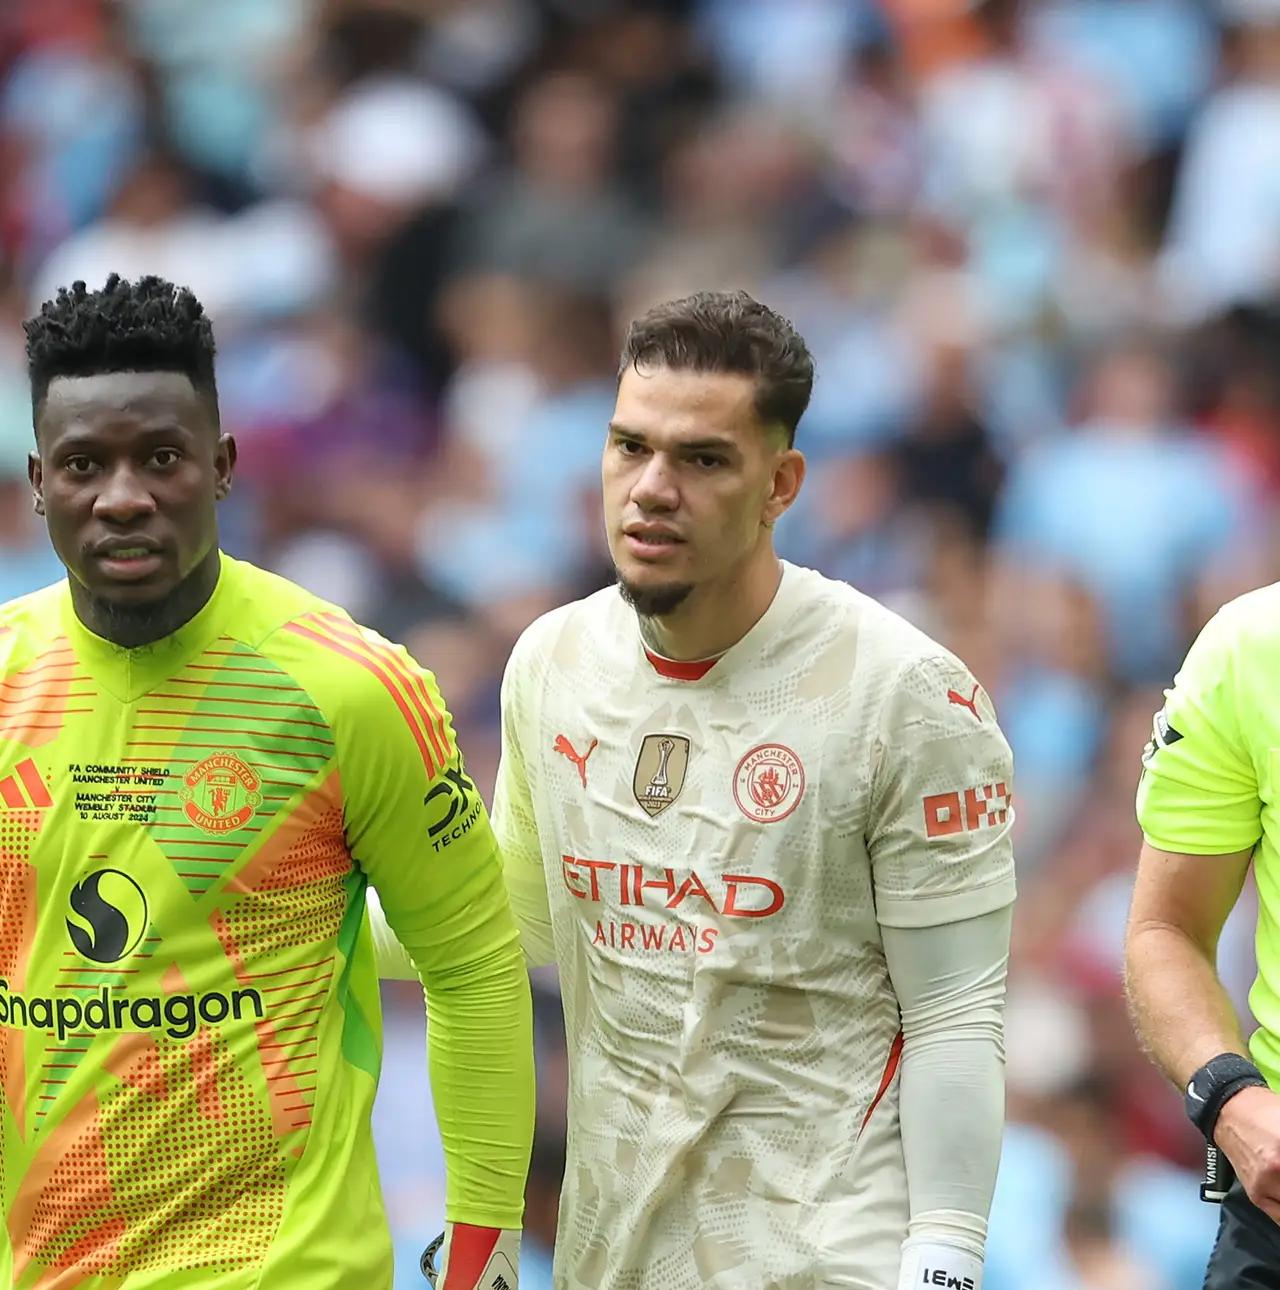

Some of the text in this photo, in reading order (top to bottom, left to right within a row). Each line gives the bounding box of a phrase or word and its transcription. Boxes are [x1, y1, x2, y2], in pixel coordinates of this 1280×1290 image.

[745, 749, 798, 776] MANCHESTER
[69, 764, 170, 777] FA COMMUNITY SHIELD
[190, 758, 254, 786] MANCHESTER
[72, 774, 164, 787] MANCHESTER UNITED
[645, 785, 669, 797] FIFA
[76, 792, 157, 804] MANCHESTER CITY
[75, 802, 157, 814] WEMBLEY STADIUM
[755, 808, 776, 817] CITY
[80, 812, 88, 820] 10
[92, 812, 125, 821] AUGUST
[195, 813, 241, 829] UNITED
[432, 800, 483, 852] TECHNO
[562, 855, 785, 918] ETIHAD
[593, 920, 718, 953] AIRWAYS
